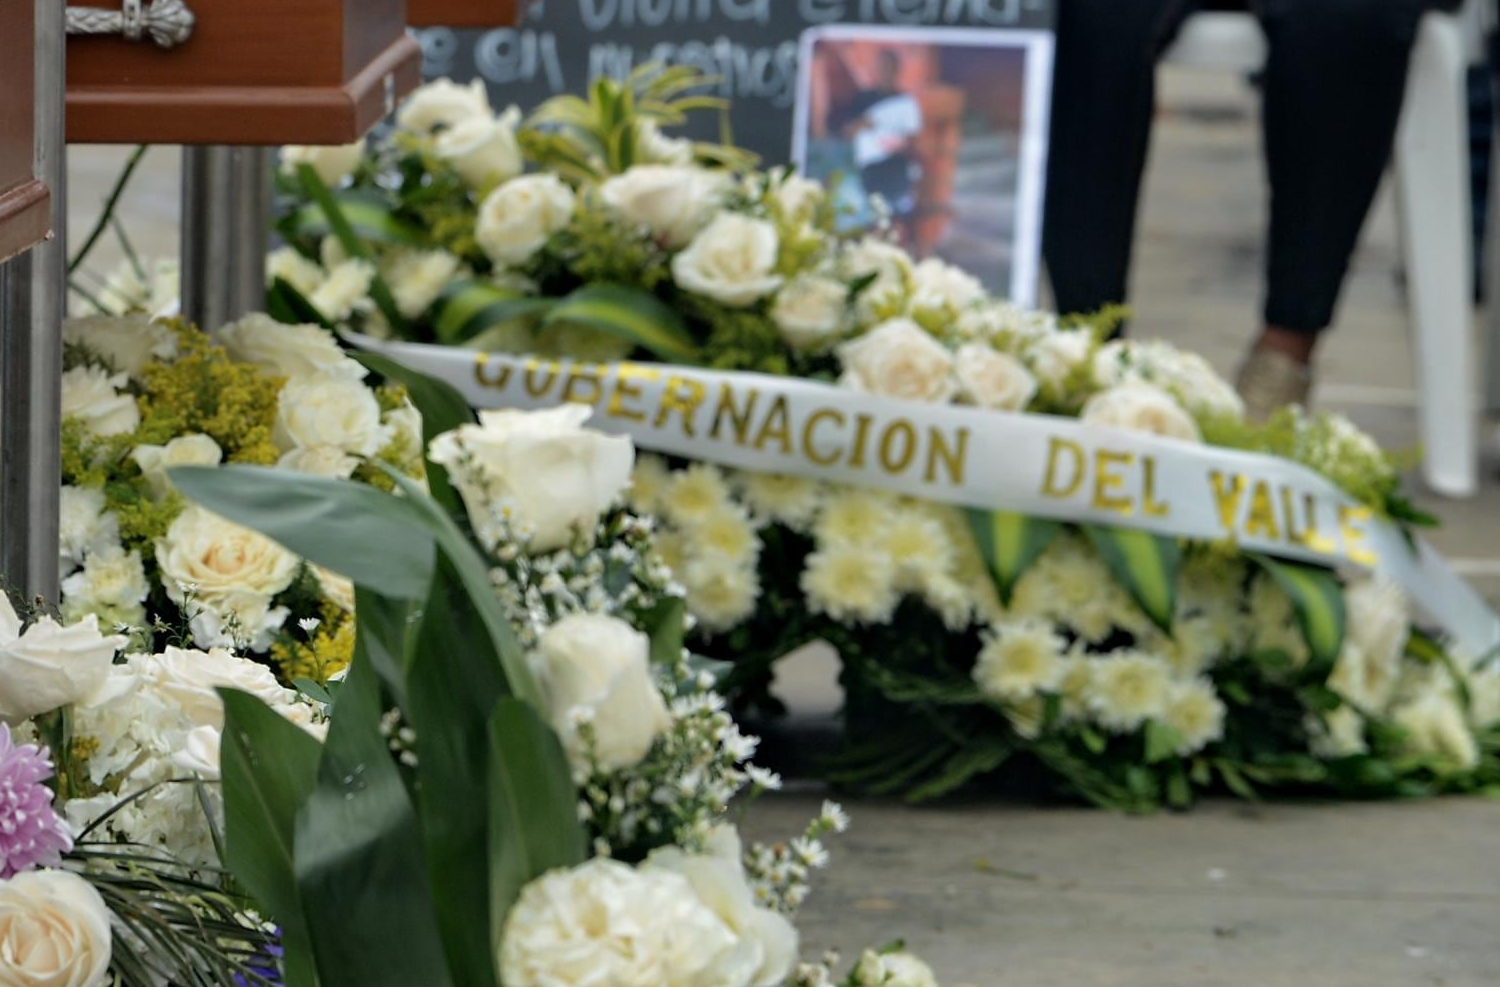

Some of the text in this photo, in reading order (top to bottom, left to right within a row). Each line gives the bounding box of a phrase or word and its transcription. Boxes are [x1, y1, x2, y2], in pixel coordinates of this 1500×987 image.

[472, 351, 1378, 567] GOBERNACION DEL VALLE
